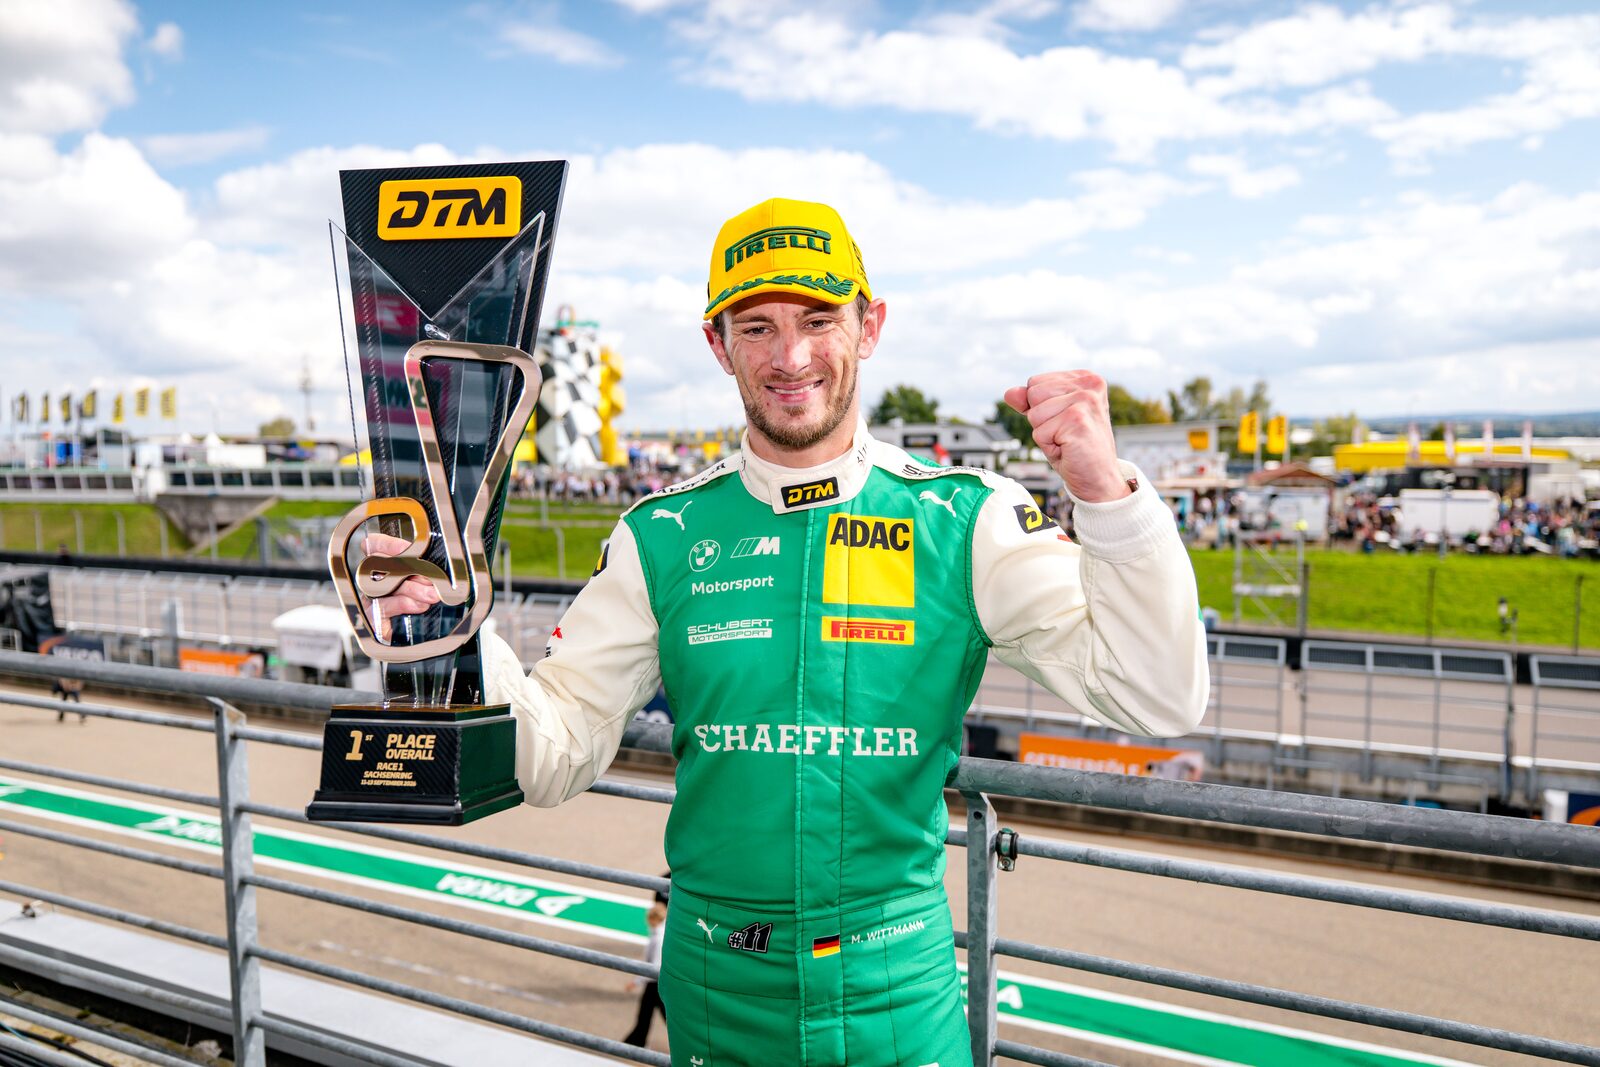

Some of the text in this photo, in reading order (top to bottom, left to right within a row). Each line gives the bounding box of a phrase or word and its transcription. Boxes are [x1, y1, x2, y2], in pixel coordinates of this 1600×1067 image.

[387, 188, 506, 228] DTM
[725, 226, 831, 272] PIRELLI
[787, 481, 834, 505] DTM
[830, 517, 910, 551] ADAC
[691, 575, 775, 595] Motorsport
[687, 618, 774, 635] SCHUBERT
[691, 629, 769, 643] MOTORSPORT
[831, 620, 906, 641] PIRELLI
[386, 734, 436, 749] PLACE
[694, 724, 919, 756] SCHAEFFLER
[385, 749, 435, 761] OVERALL
[363, 770, 413, 780] SACHSENRING
[376, 762, 403, 771] RACE 1
[727, 922, 773, 953] #11
[851, 919, 925, 945] M. WITTMANN
